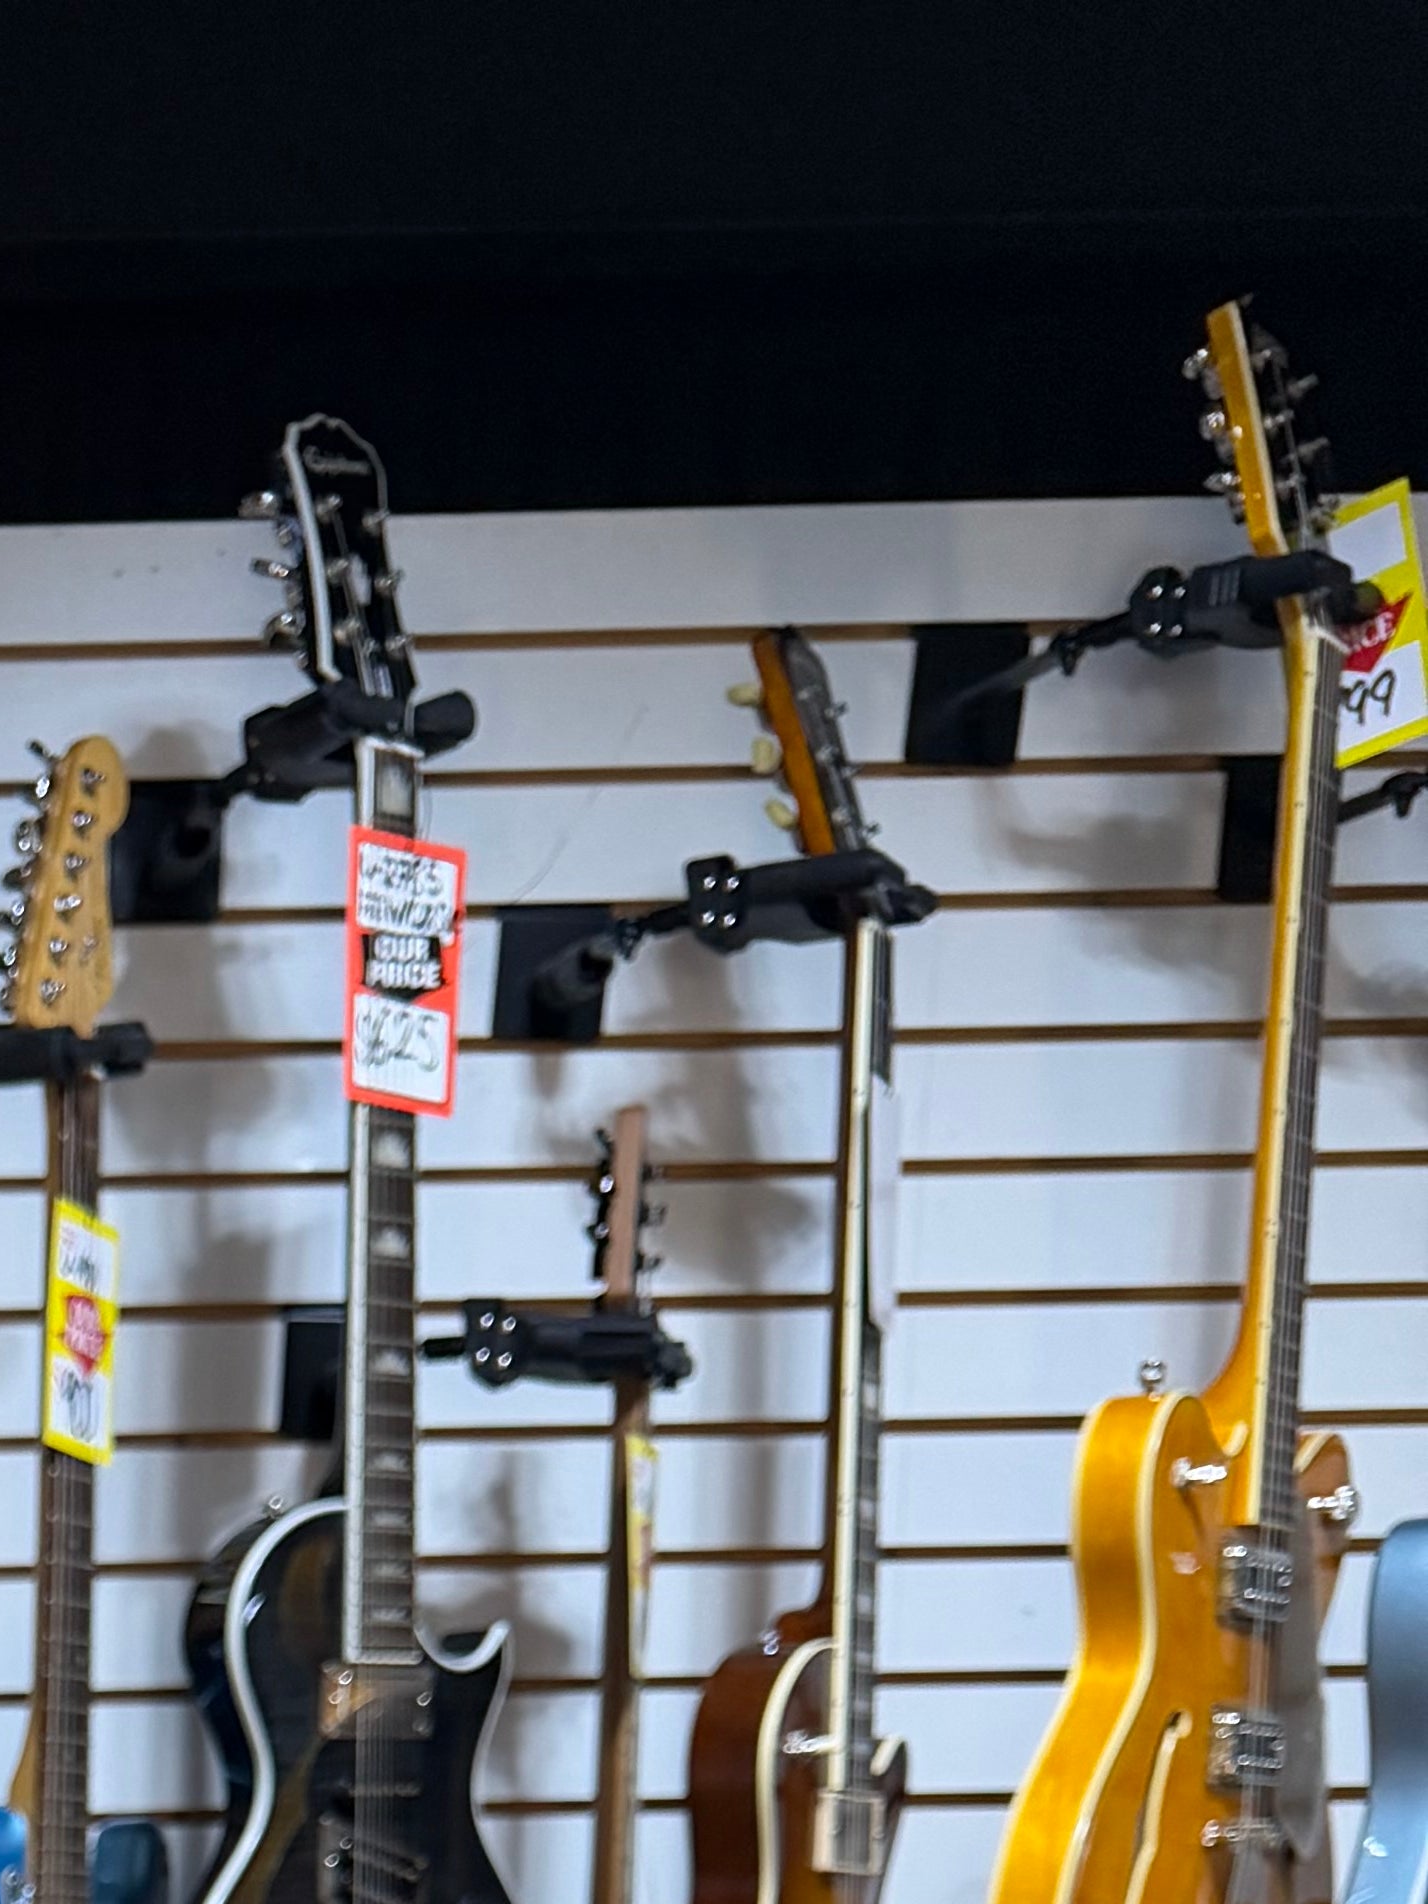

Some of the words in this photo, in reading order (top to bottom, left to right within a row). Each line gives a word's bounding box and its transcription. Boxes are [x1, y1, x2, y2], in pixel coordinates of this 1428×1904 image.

[1340, 668, 1397, 727] 99
[373, 935, 430, 961] OUR
[365, 959, 442, 990] PRICE
